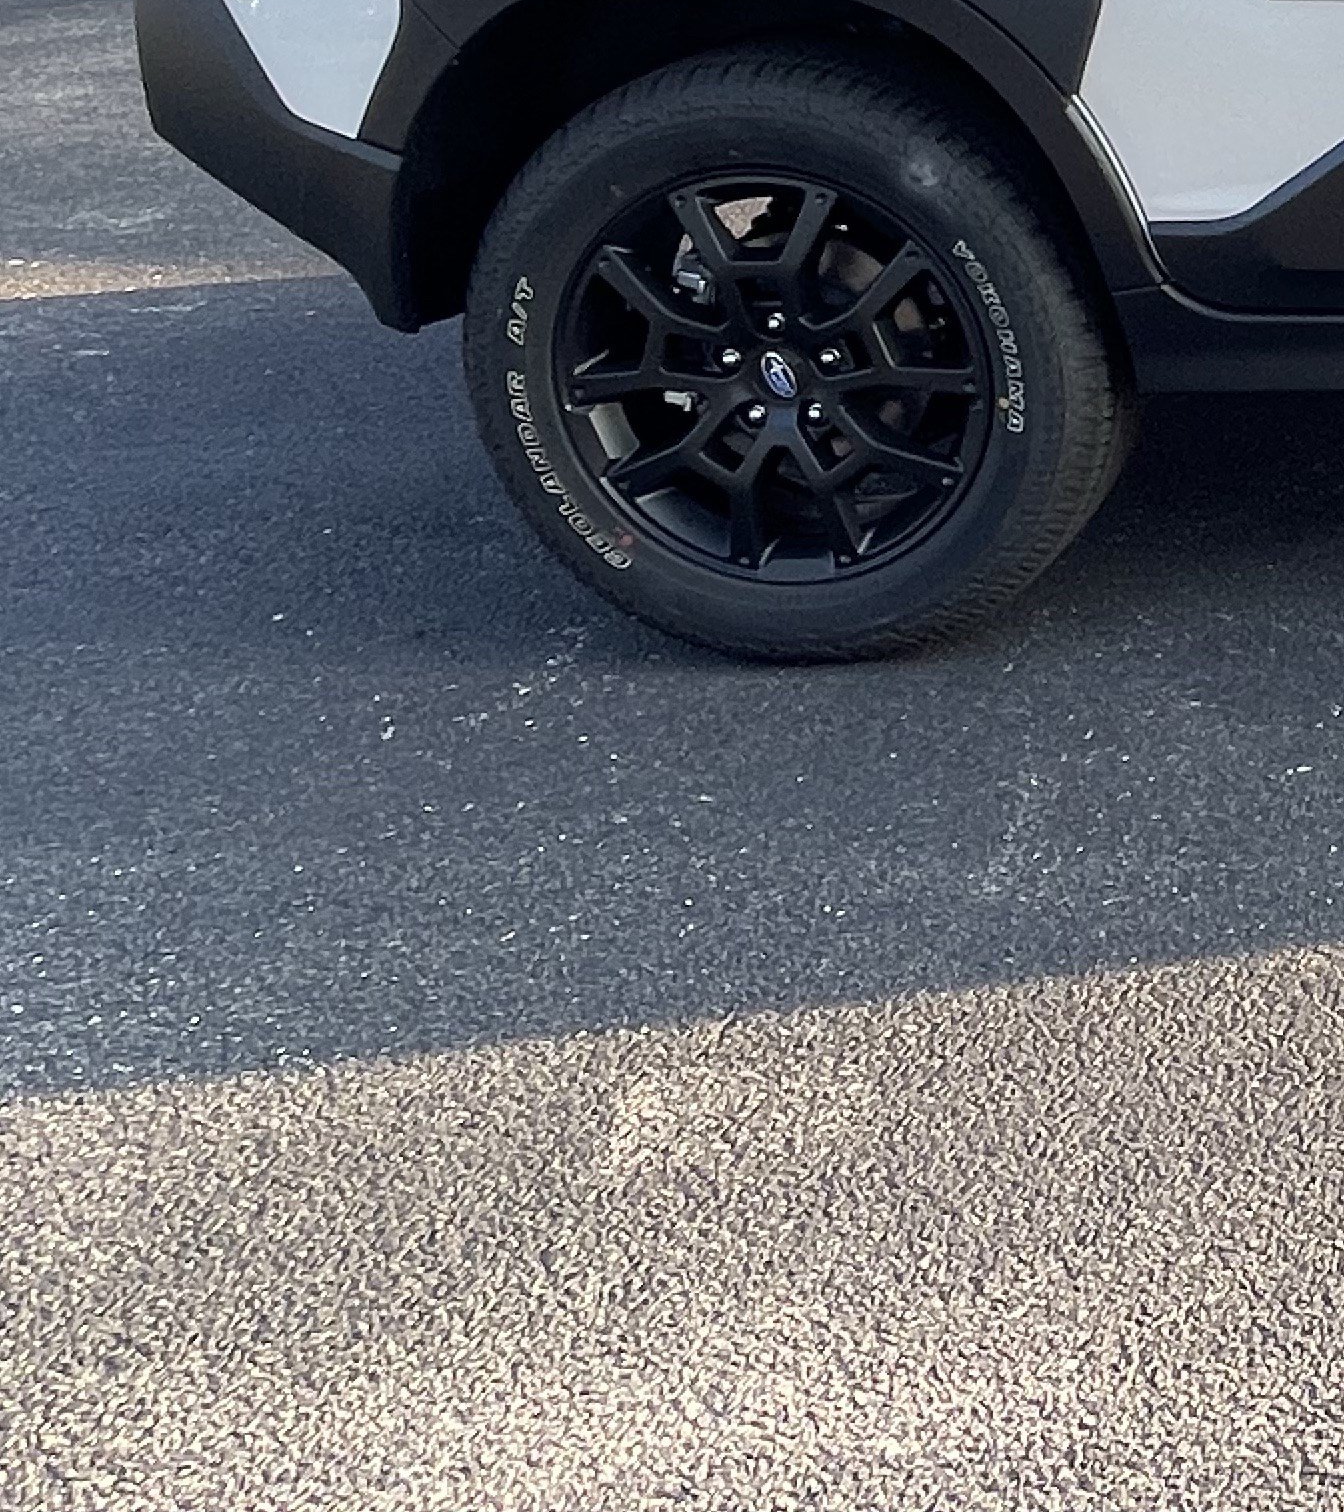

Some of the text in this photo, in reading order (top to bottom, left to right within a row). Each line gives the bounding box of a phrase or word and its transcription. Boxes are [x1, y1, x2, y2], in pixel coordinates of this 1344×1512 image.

[507, 276, 632, 569] GEOLANDAR A/T
[953, 240, 1024, 432] YOKOHAMA
